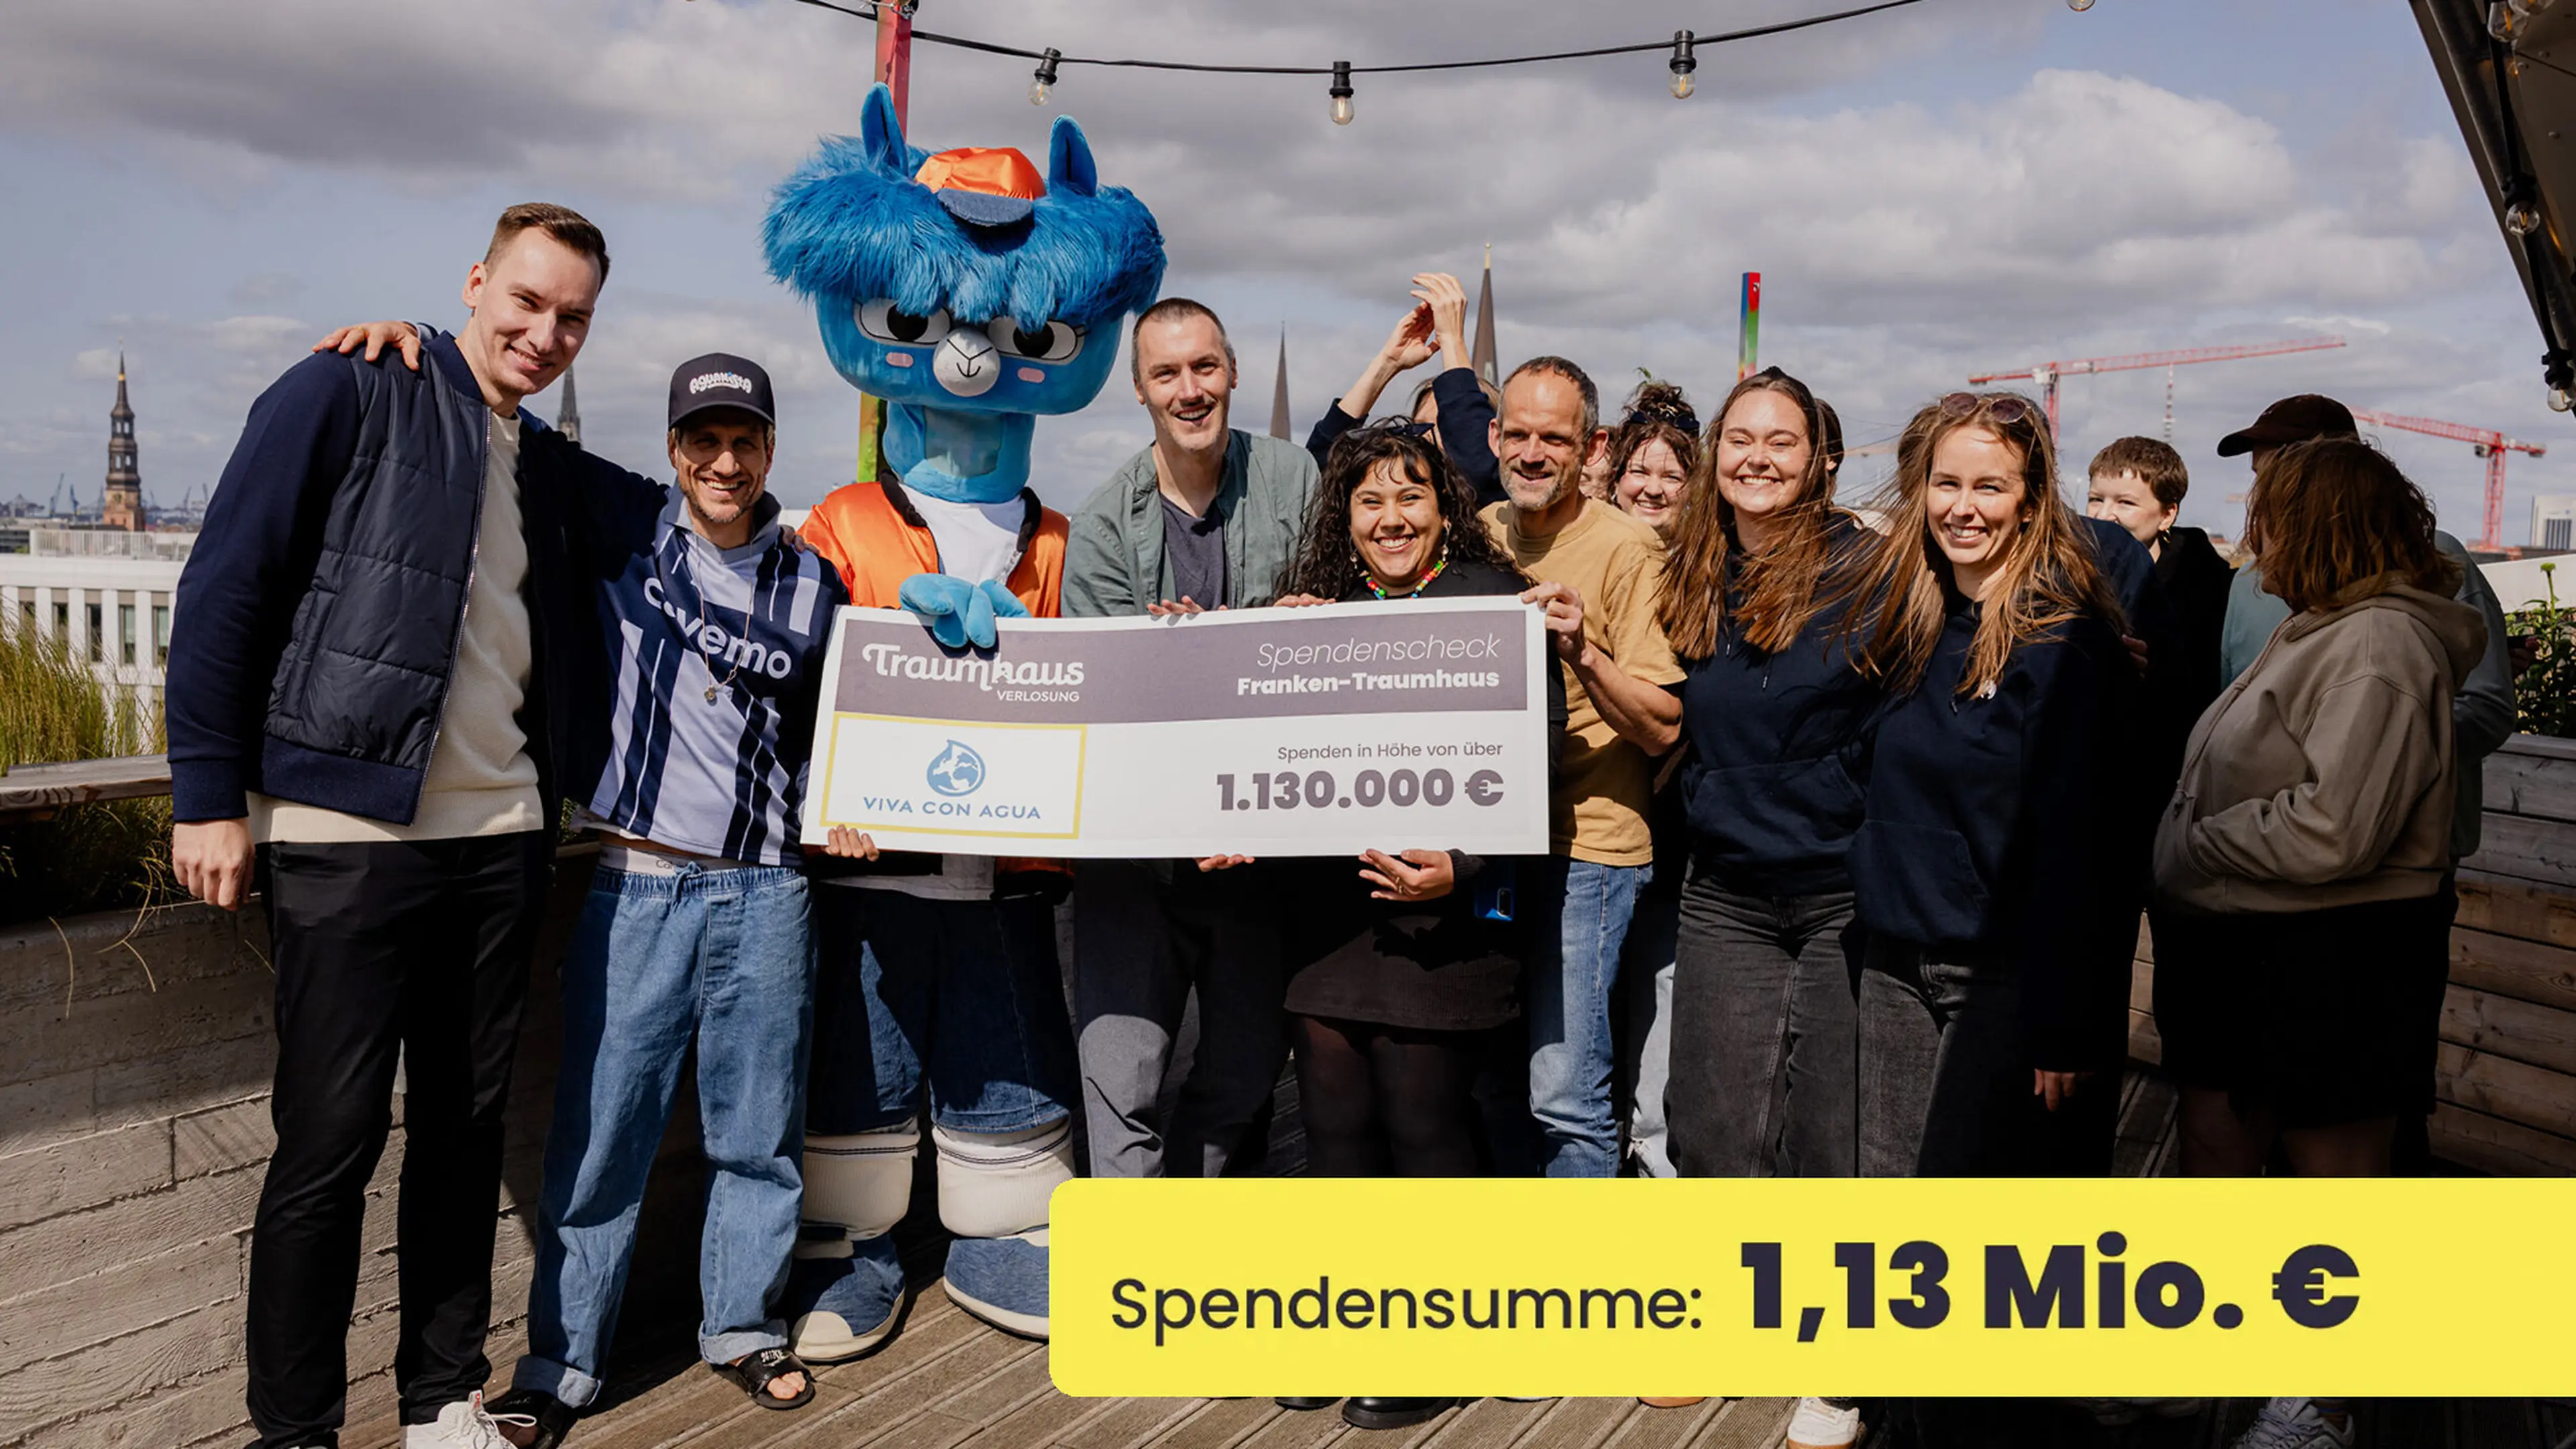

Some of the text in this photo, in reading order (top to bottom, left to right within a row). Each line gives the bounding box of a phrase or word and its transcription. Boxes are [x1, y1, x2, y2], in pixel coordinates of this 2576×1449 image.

[1256, 632, 1501, 674] Spendenscheck
[861, 643, 1085, 692] Traumhaus
[996, 690, 1080, 702] VERLOSUNG
[1236, 669, 1501, 696] Franken-Traumhaus
[1278, 741, 1503, 764] Spenden in Höhe von über
[1216, 769, 1504, 811] 1.130.000 €
[863, 796, 1040, 820] VIVA CON AGUA
